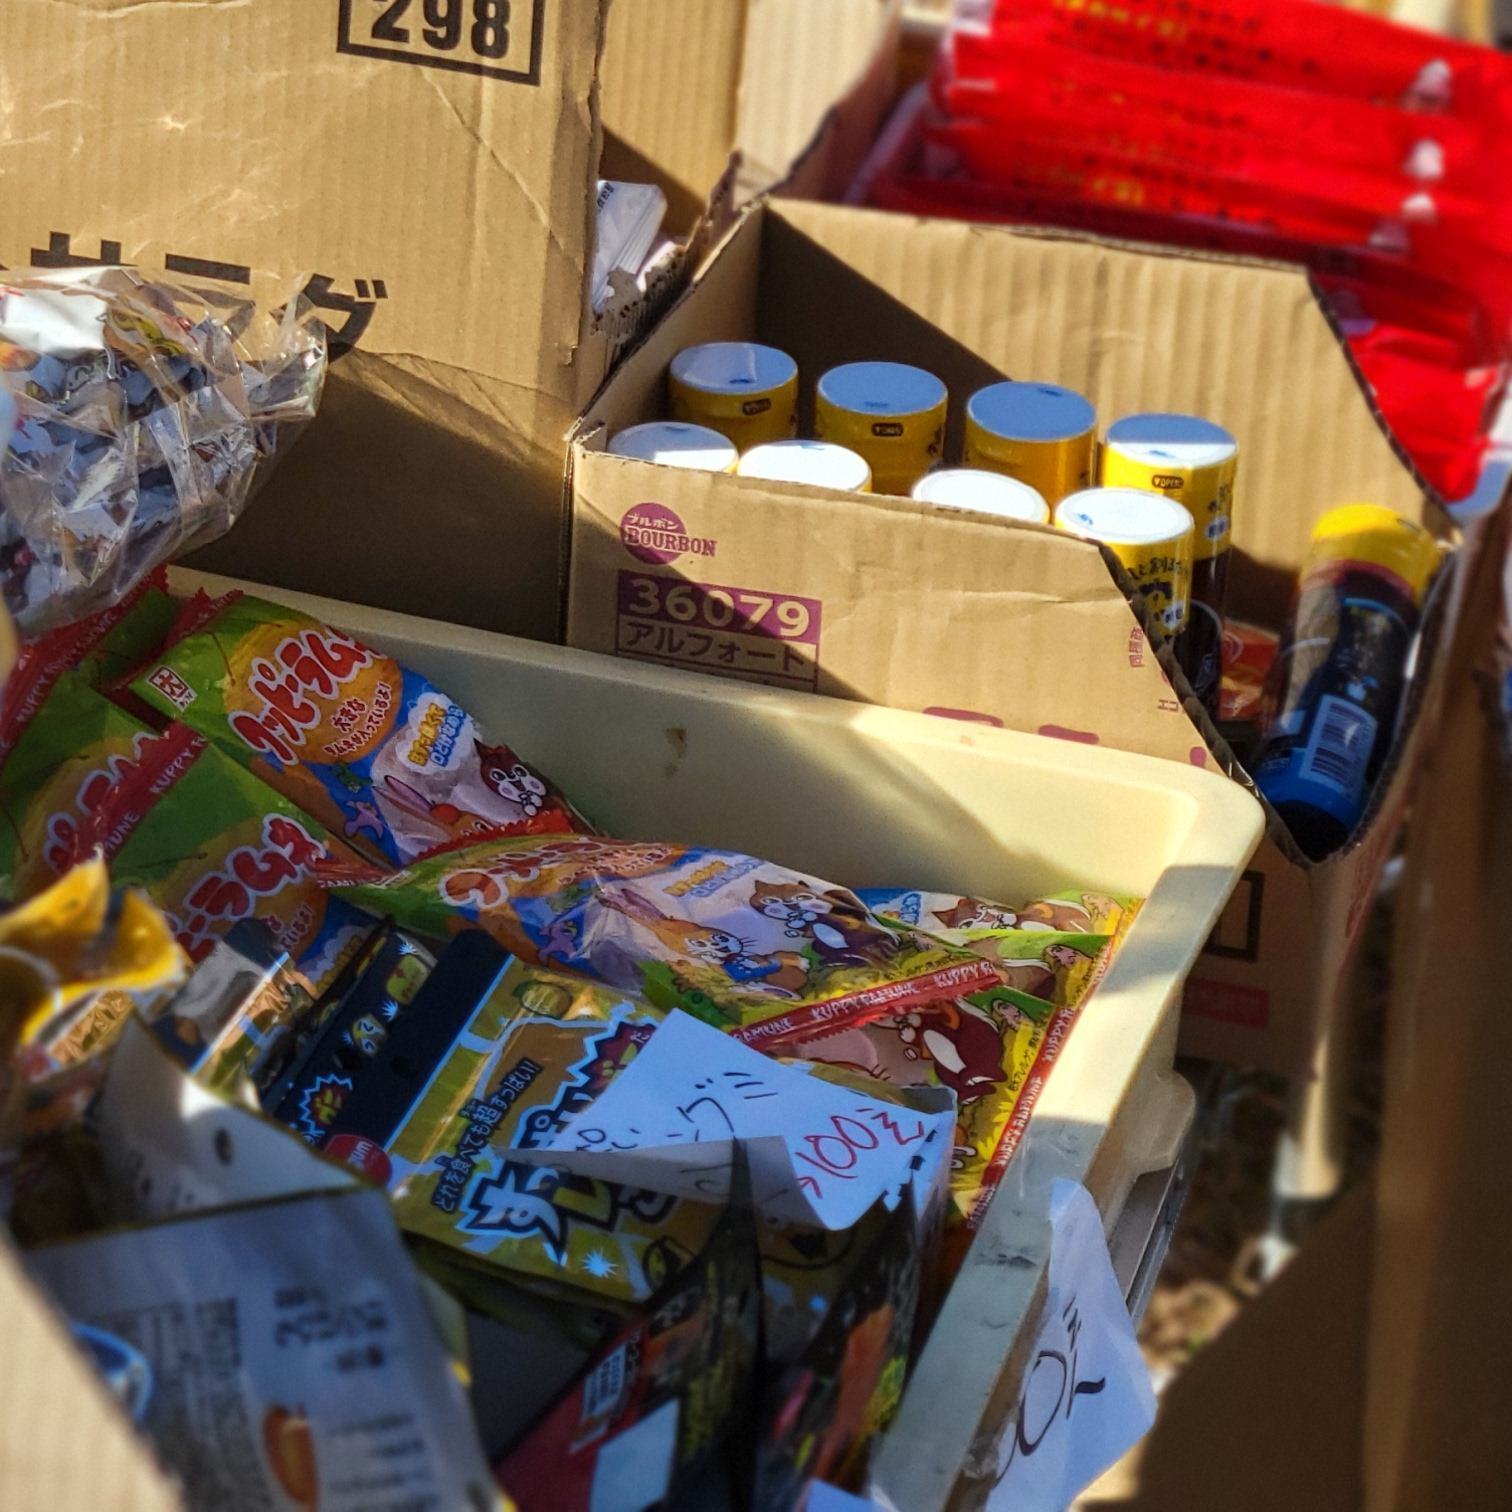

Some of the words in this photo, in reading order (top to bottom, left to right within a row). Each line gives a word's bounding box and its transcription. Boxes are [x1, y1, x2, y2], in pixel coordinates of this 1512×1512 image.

[624, 527, 718, 557] BOURBON
[629, 577, 811, 638] 36079
[626, 620, 806, 673] アルフォート
[332, 696, 366, 733] 大きな
[149, 748, 194, 795] KUPPY
[811, 995, 860, 1021] KUPPY
[933, 964, 979, 988] KUPPY
